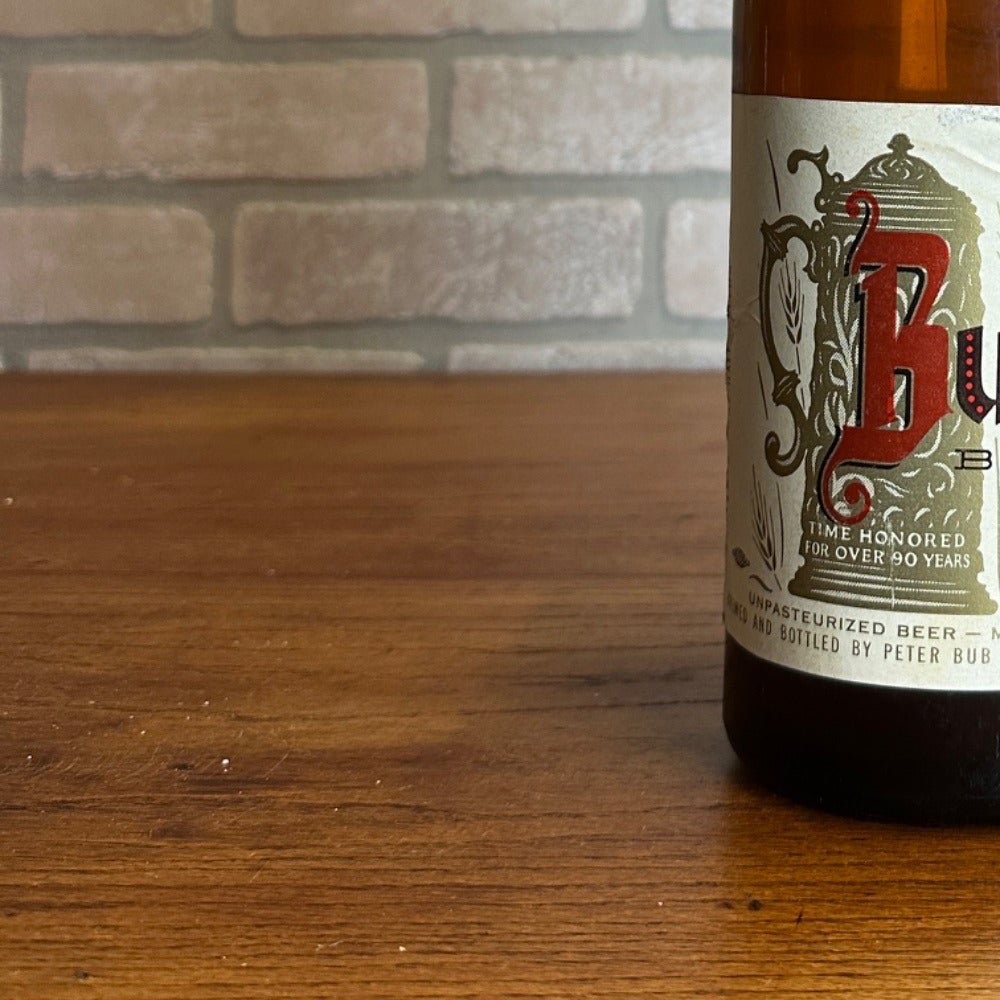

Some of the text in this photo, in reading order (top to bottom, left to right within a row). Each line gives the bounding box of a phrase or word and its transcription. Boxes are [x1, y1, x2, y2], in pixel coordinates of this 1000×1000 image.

[808, 520, 966, 549] TIME HONORED
[805, 540, 971, 569] FOR OVER 90 YEARS
[748, 591, 885, 634] UNPASTEURIZED
[896, 624, 956, 641] BEER
[752, 613, 772, 636] AND
[780, 623, 840, 653] BOTTLED
[851, 639, 871, 657] BY
[883, 642, 940, 663] PETER
[953, 647, 991, 665] BUB
